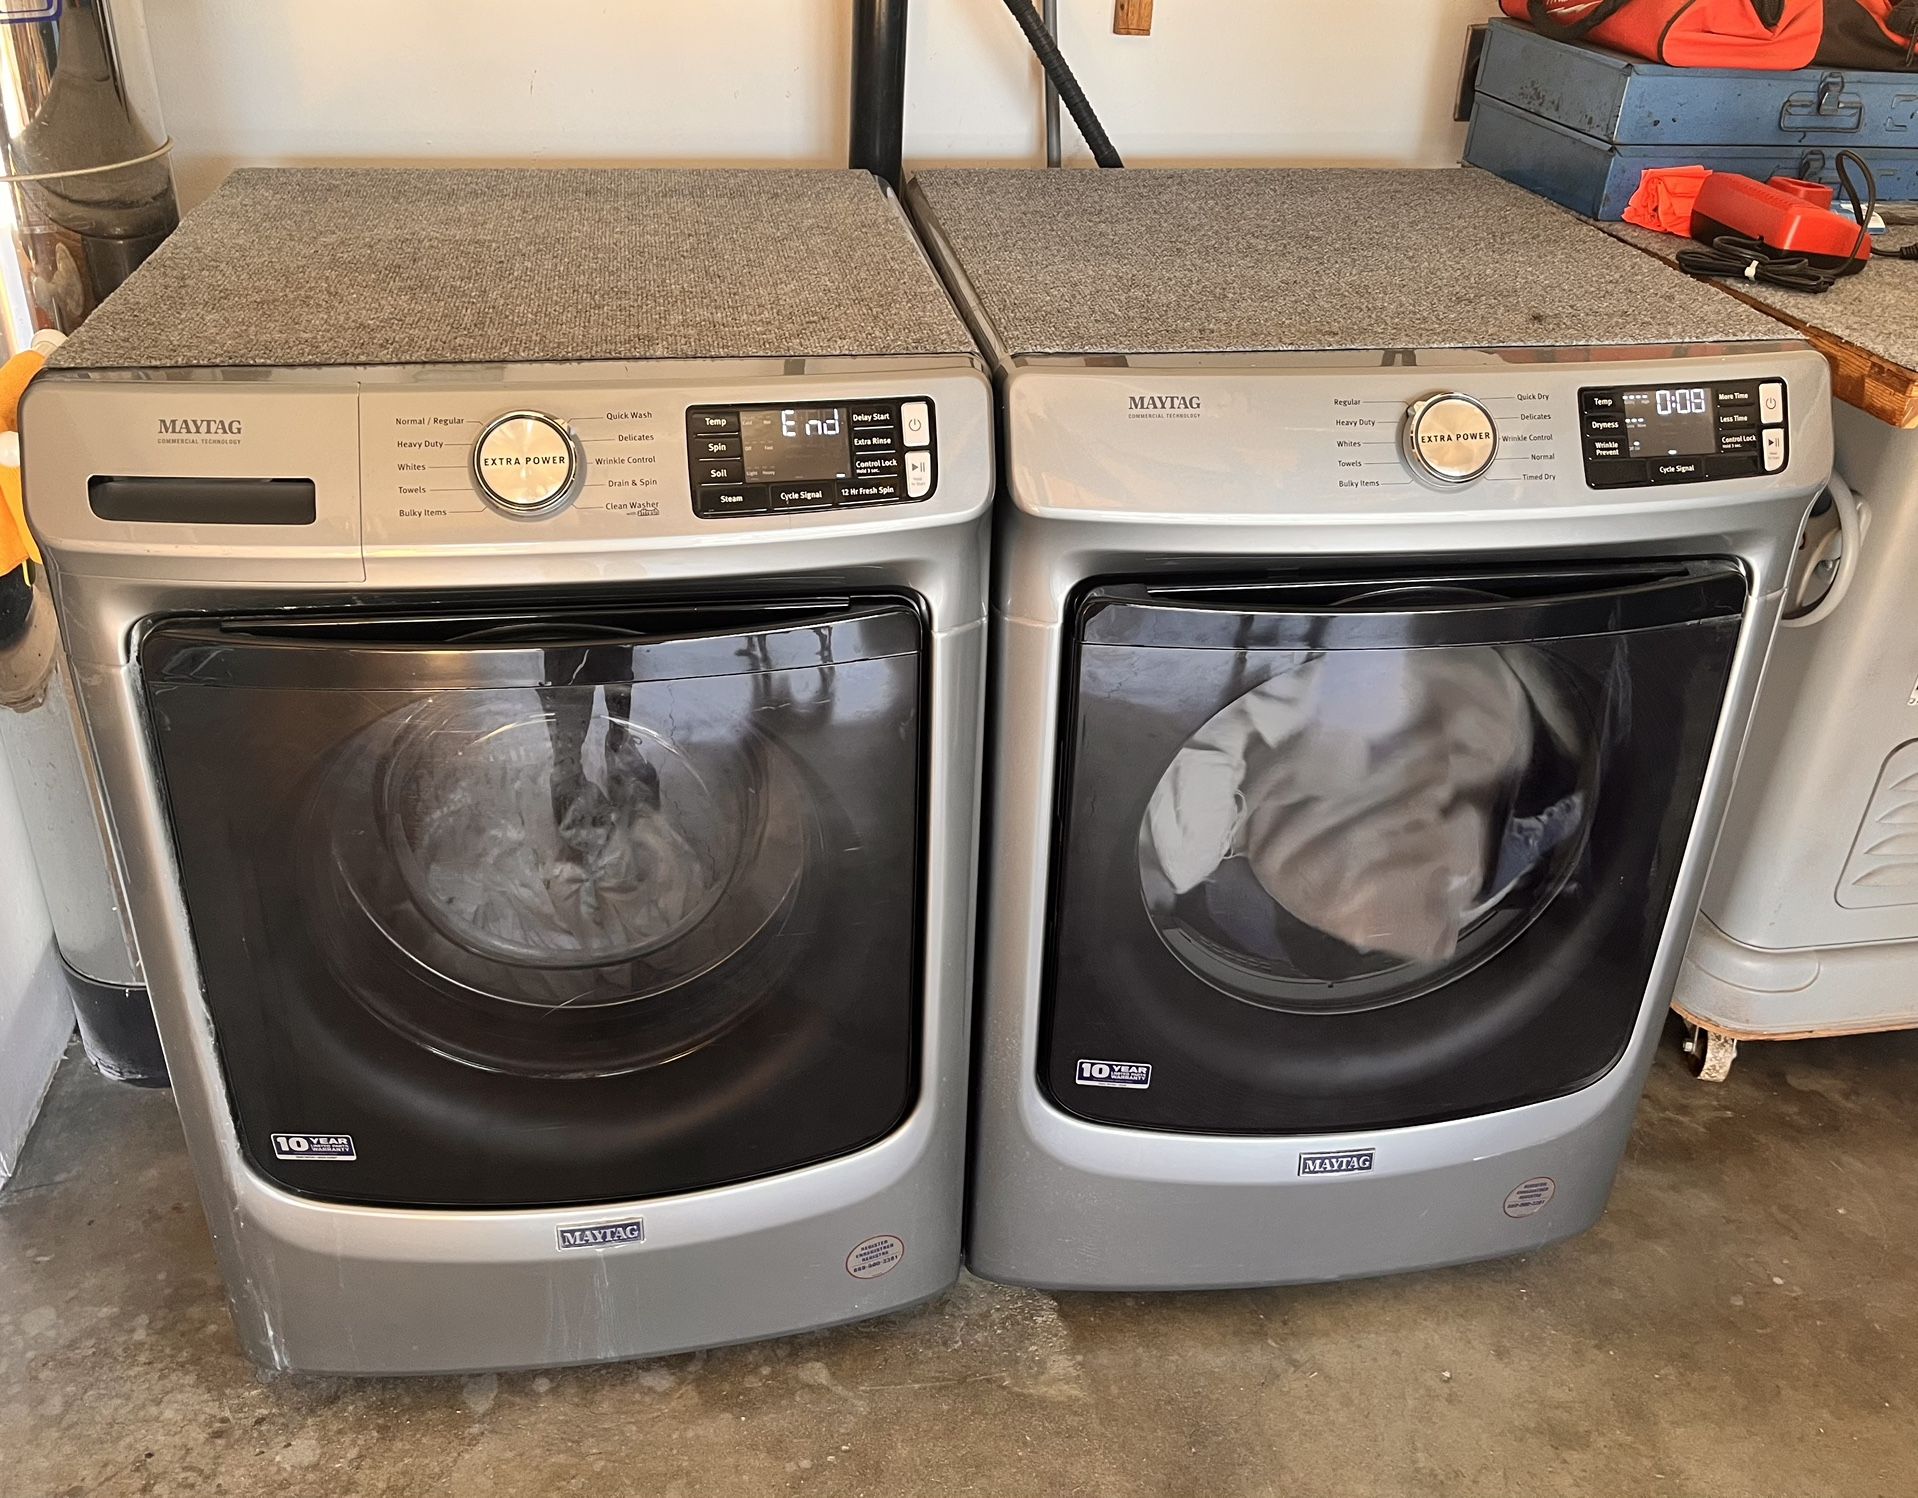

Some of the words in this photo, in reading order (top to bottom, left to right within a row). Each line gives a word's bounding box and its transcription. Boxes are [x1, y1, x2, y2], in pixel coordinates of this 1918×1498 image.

[1517, 393, 1536, 401] Quick
[1656, 388, 1705, 415] 0:08
[1128, 396, 1201, 410] MAYTAG
[1334, 399, 1361, 407] Regular
[1594, 398, 1613, 406] Temp
[606, 412, 629, 420] Quick
[630, 411, 653, 419] Wash
[853, 414, 872, 422] Delay
[395, 417, 425, 425] Normal
[433, 417, 464, 426] Regular
[705, 418, 727, 427] Temp
[781, 408, 840, 437] End
[1359, 419, 1376, 427] Duty
[1592, 421, 1619, 429] Dryness
[158, 418, 242, 435] MAYTAG
[618, 434, 654, 442] Delicates
[1421, 434, 1453, 443] EXTRA
[1456, 432, 1491, 441] POWER
[397, 440, 421, 449] Heavy
[424, 440, 444, 448] Duty
[708, 443, 727, 452] Spin
[484, 457, 520, 466] EXTRA
[525, 456, 565, 465] POWER
[595, 457, 626, 465] Wrinkle
[882, 459, 897, 467] Lock
[397, 463, 426, 471] Whites
[1659, 466, 1675, 474] Cycle
[1676, 465, 1694, 473] Signal
[710, 469, 727, 478] Soil
[639, 479, 658, 487] Spin
[1339, 480, 1359, 488] Bulky
[398, 486, 426, 494] Towels
[859, 487, 878, 495] Fresh
[879, 486, 894, 494] Spin
[720, 495, 743, 503] Steam
[780, 492, 799, 502] Cycle
[800, 491, 822, 500] Signal
[629, 501, 659, 509] Washer
[399, 509, 422, 518] Bulky
[1082, 1063, 1110, 1078] 10
[1112, 1065, 1147, 1073] YEAR
[276, 1136, 309, 1151] 10
[1304, 1156, 1370, 1172] MAYTAG
[563, 1225, 639, 1245] MAYTAG
